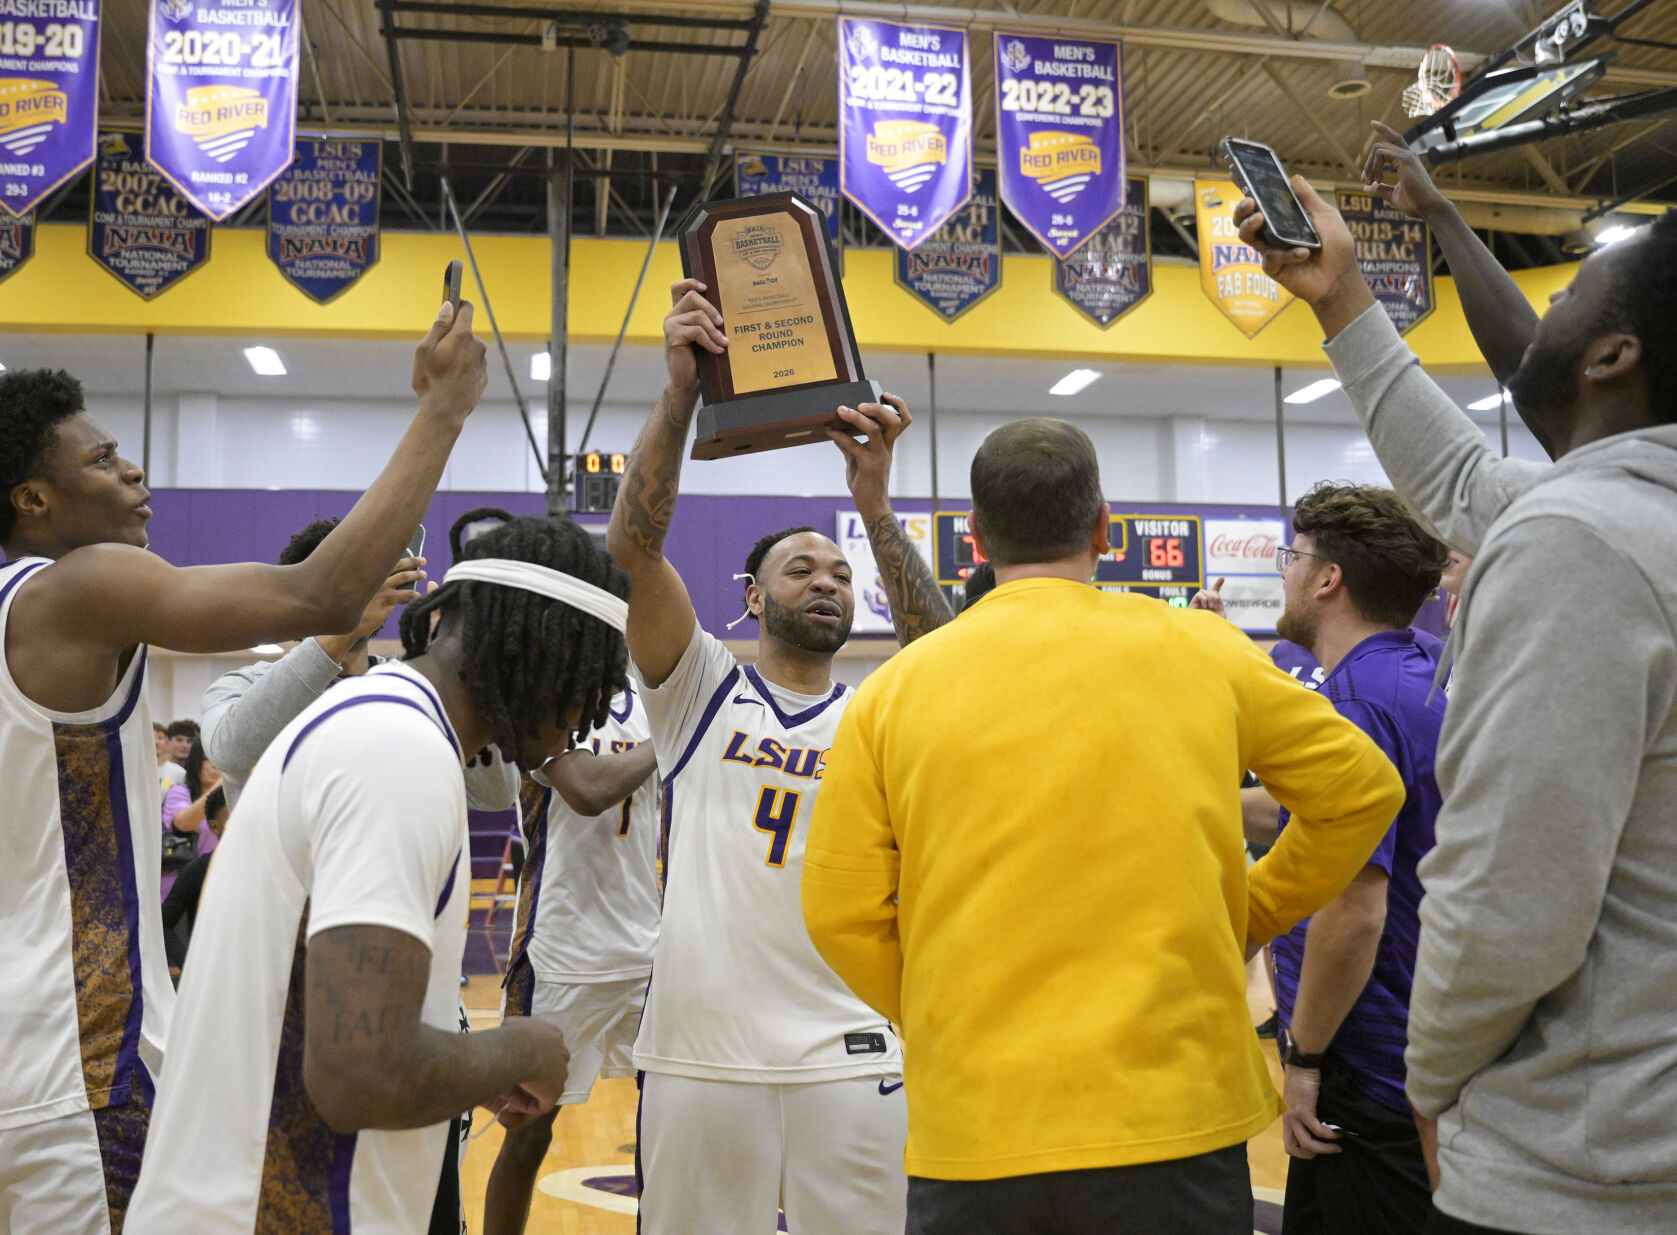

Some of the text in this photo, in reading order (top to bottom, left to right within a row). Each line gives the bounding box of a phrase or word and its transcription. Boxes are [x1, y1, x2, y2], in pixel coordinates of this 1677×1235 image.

[197, 9, 289, 27] BASKETBALL
[0, 21, 83, 58] 19-20
[163, 30, 283, 66] 2020-21
[900, 32, 941, 51] MEN'S
[881, 46, 961, 69] BASKETBALL
[1053, 45, 1095, 61] MEN'S
[1034, 60, 1114, 81] BASKETBALL
[851, 65, 958, 107] 2021-22
[15, 94, 64, 114] RIVER
[1001, 78, 1114, 118] 2022-23
[179, 102, 265, 125] RED RIVER
[313, 142, 362, 159] LSUS
[869, 137, 944, 157] RED RIVER
[317, 159, 357, 170] MEN'S
[778, 157, 824, 174] LSUS
[1023, 148, 1098, 168] RED RIVER
[191, 171, 248, 184] RANKED #2
[294, 169, 378, 182] BASKETBALL
[780, 174, 819, 185] MEN'S
[1340, 194, 1372, 213] LSU
[290, 202, 359, 224] GCAC
[106, 227, 193, 256] NAIA
[284, 238, 364, 262] NAIA
[735, 236, 780, 249] BASKETBALL
[120, 249, 177, 260] NATIONAL
[1212, 245, 1264, 271] NAI
[109, 256, 188, 271] TOURNAMENT
[295, 259, 350, 270] NATIONAL
[911, 253, 986, 280] NAIA
[1358, 261, 1420, 273] HAMPIONS
[286, 267, 360, 279] TOURNAMENT
[922, 274, 975, 286] NATIONAL
[1065, 263, 1138, 290] NAIA
[914, 281, 985, 294] TOURNAMENT
[1217, 272, 1279, 302] FAB FOUR
[734, 315, 814, 334] FIRST & SECOND
[759, 329, 793, 341] ROUND
[752, 338, 805, 352] CHAMPION
[773, 369, 795, 378] 2026
[1134, 520, 1190, 537] VISITOR
[1150, 538, 1184, 567] 66
[1142, 569, 1173, 581] BONUS
[1159, 586, 1188, 597] FOULS
[1222, 599, 1281, 609] OWERADE
[752, 784, 802, 868] 4
[874, 1038, 880, 1046] L
